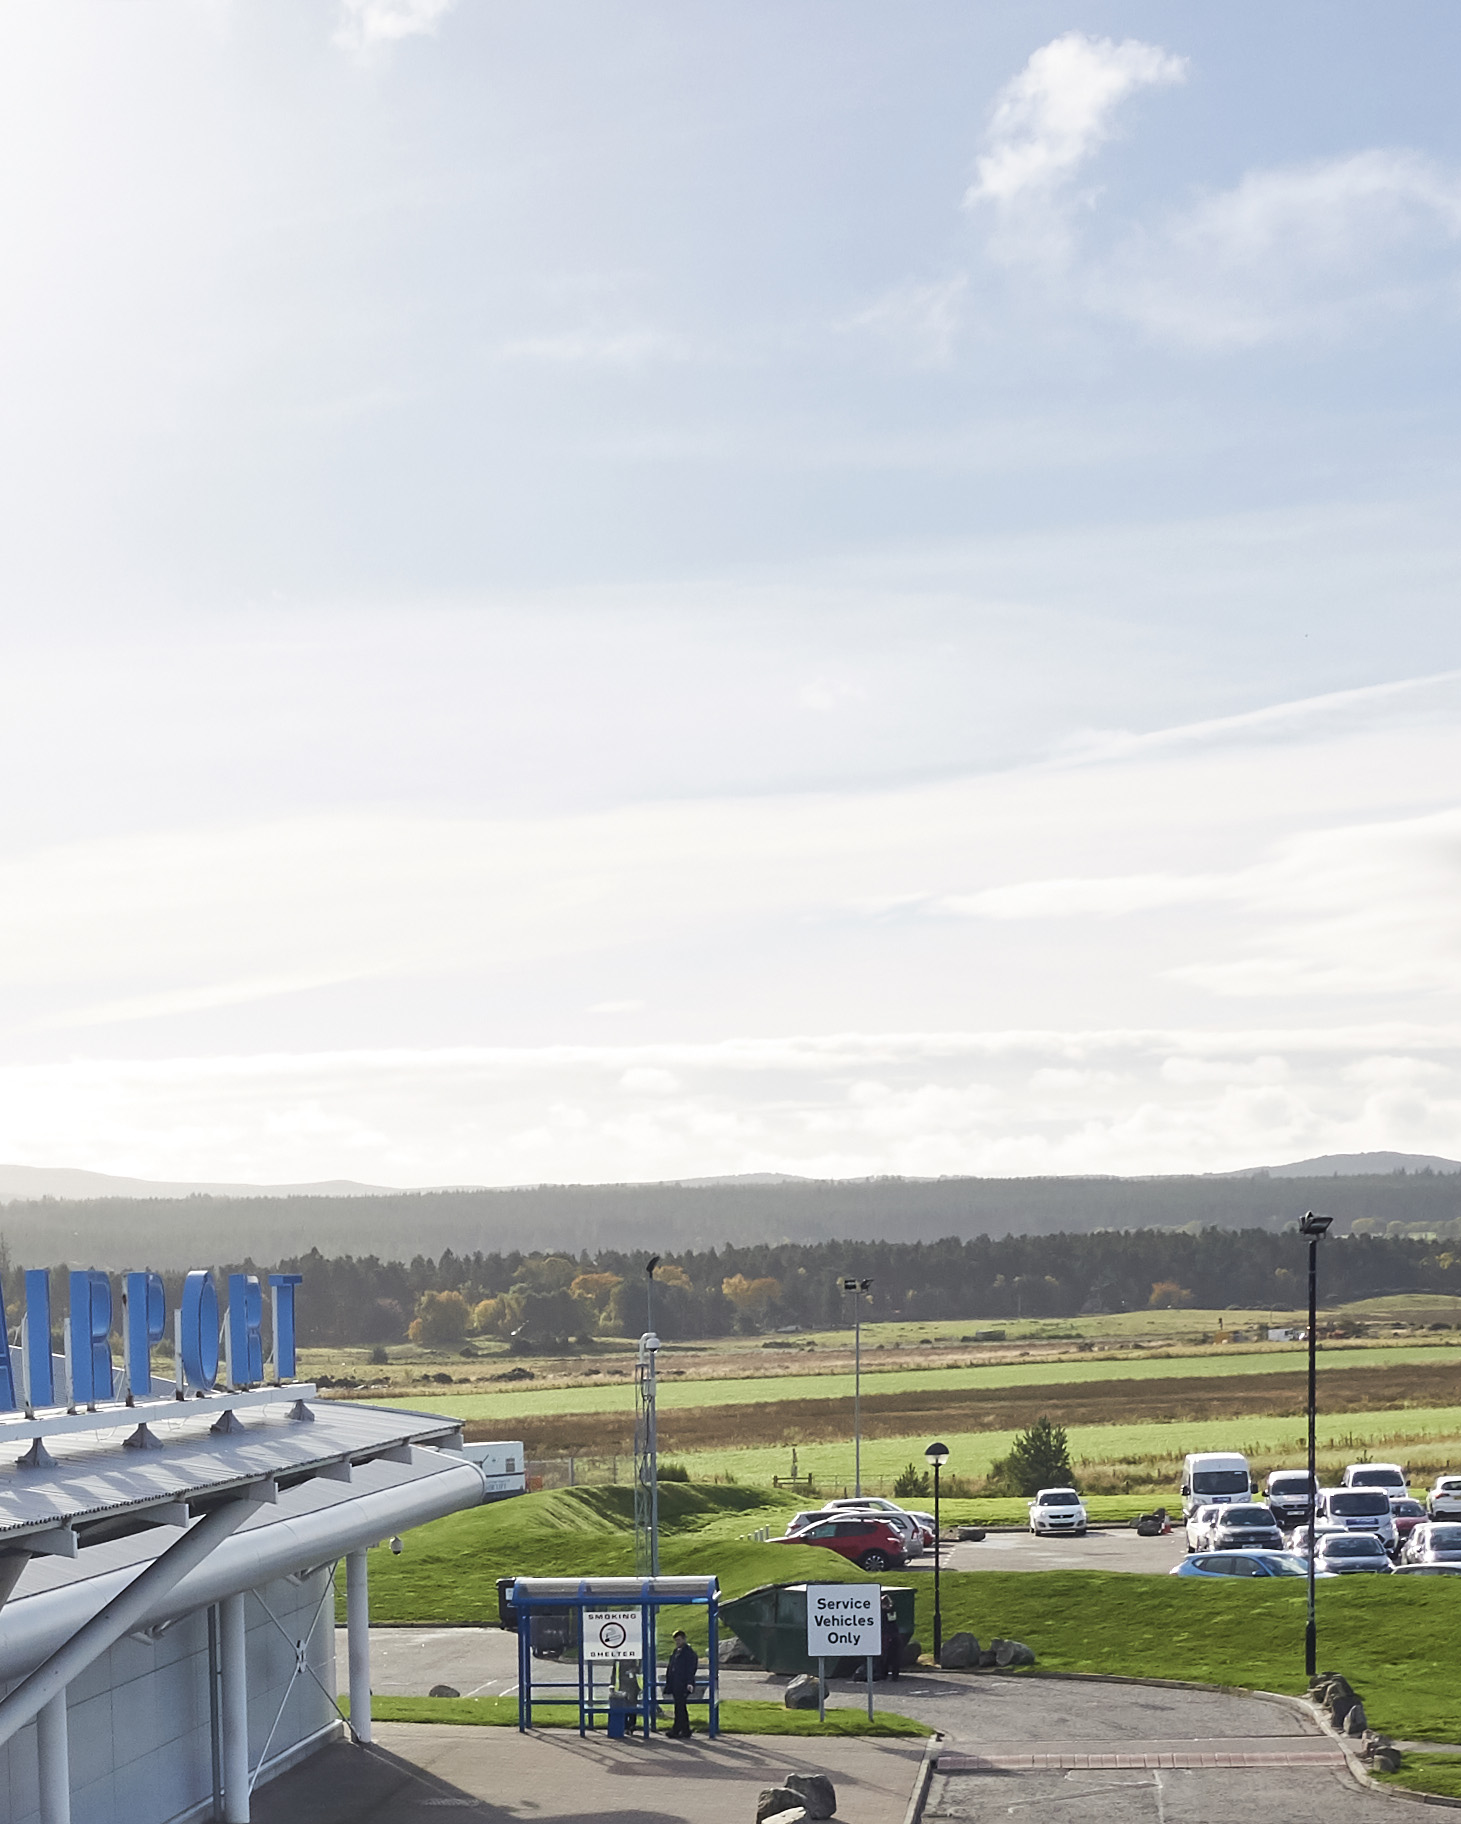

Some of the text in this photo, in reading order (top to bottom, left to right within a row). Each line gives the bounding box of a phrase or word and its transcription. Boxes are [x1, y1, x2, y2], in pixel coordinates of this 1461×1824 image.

[817, 1597, 871, 1610] Service
[814, 1614, 874, 1627] Vehicles
[827, 1631, 861, 1646] Only
